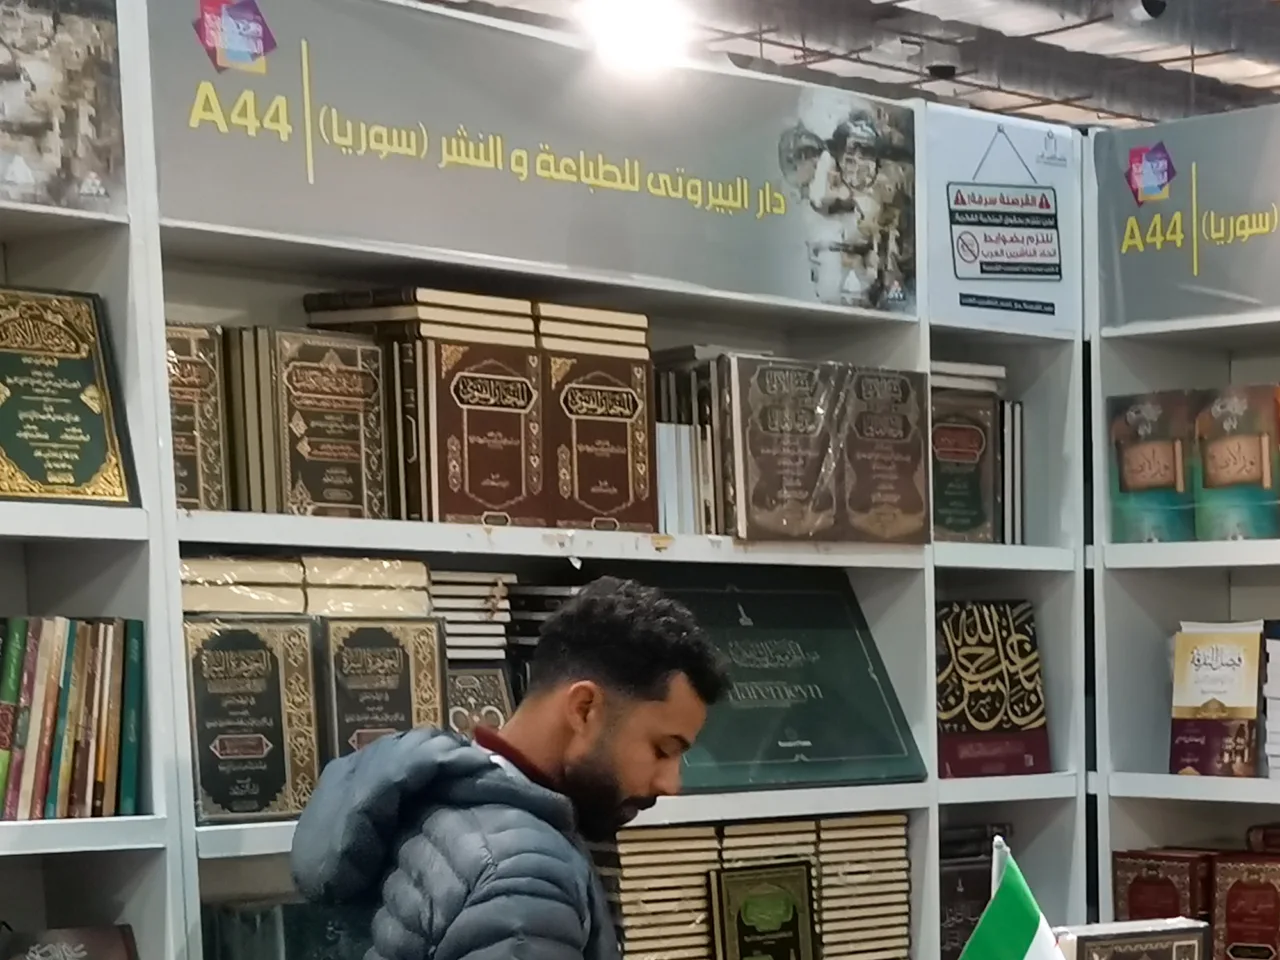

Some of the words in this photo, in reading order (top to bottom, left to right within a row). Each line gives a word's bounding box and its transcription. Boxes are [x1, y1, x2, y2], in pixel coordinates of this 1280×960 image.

[188, 81, 293, 143] A44
[319, 104, 428, 158] (سوريا)
[438, 126, 503, 170] النشر
[510, 149, 529, 182] و
[535, 144, 640, 193] للطباعة
[756, 183, 787, 219] دار
[1121, 211, 1185, 253] A44
[1202, 204, 1278, 246] (سوريا)
